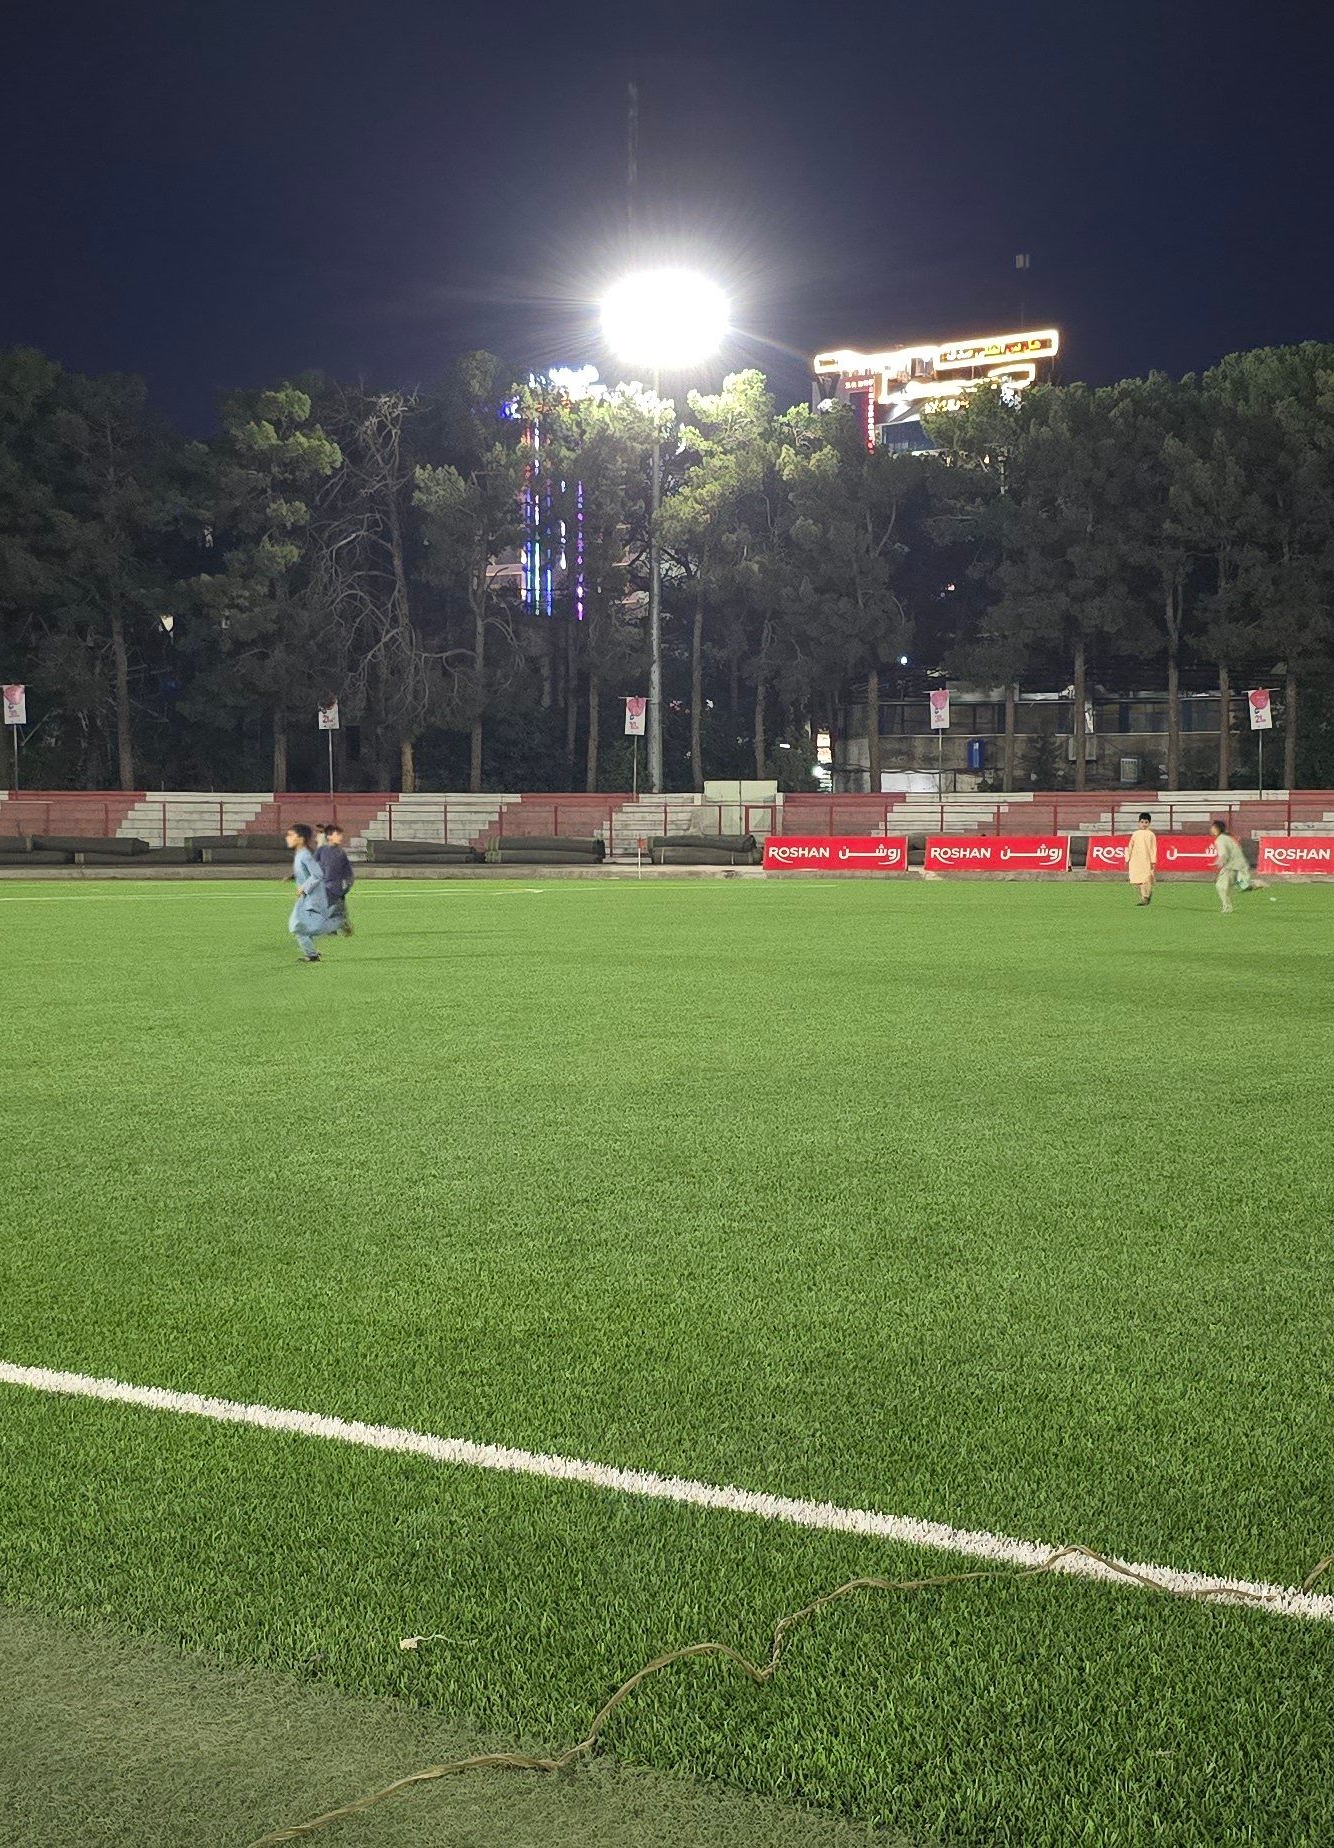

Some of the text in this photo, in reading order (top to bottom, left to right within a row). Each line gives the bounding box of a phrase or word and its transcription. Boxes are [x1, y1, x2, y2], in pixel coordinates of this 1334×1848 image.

[769, 847, 829, 863] ROSHAN
[838, 845, 901, 865] روشن
[931, 846, 991, 864] ROSHAN
[1000, 844, 1063, 865] روشن
[1093, 847, 1128, 864] ROS
[1167, 845, 1217, 866] شن
[1264, 848, 1330, 866] ROSHAN
